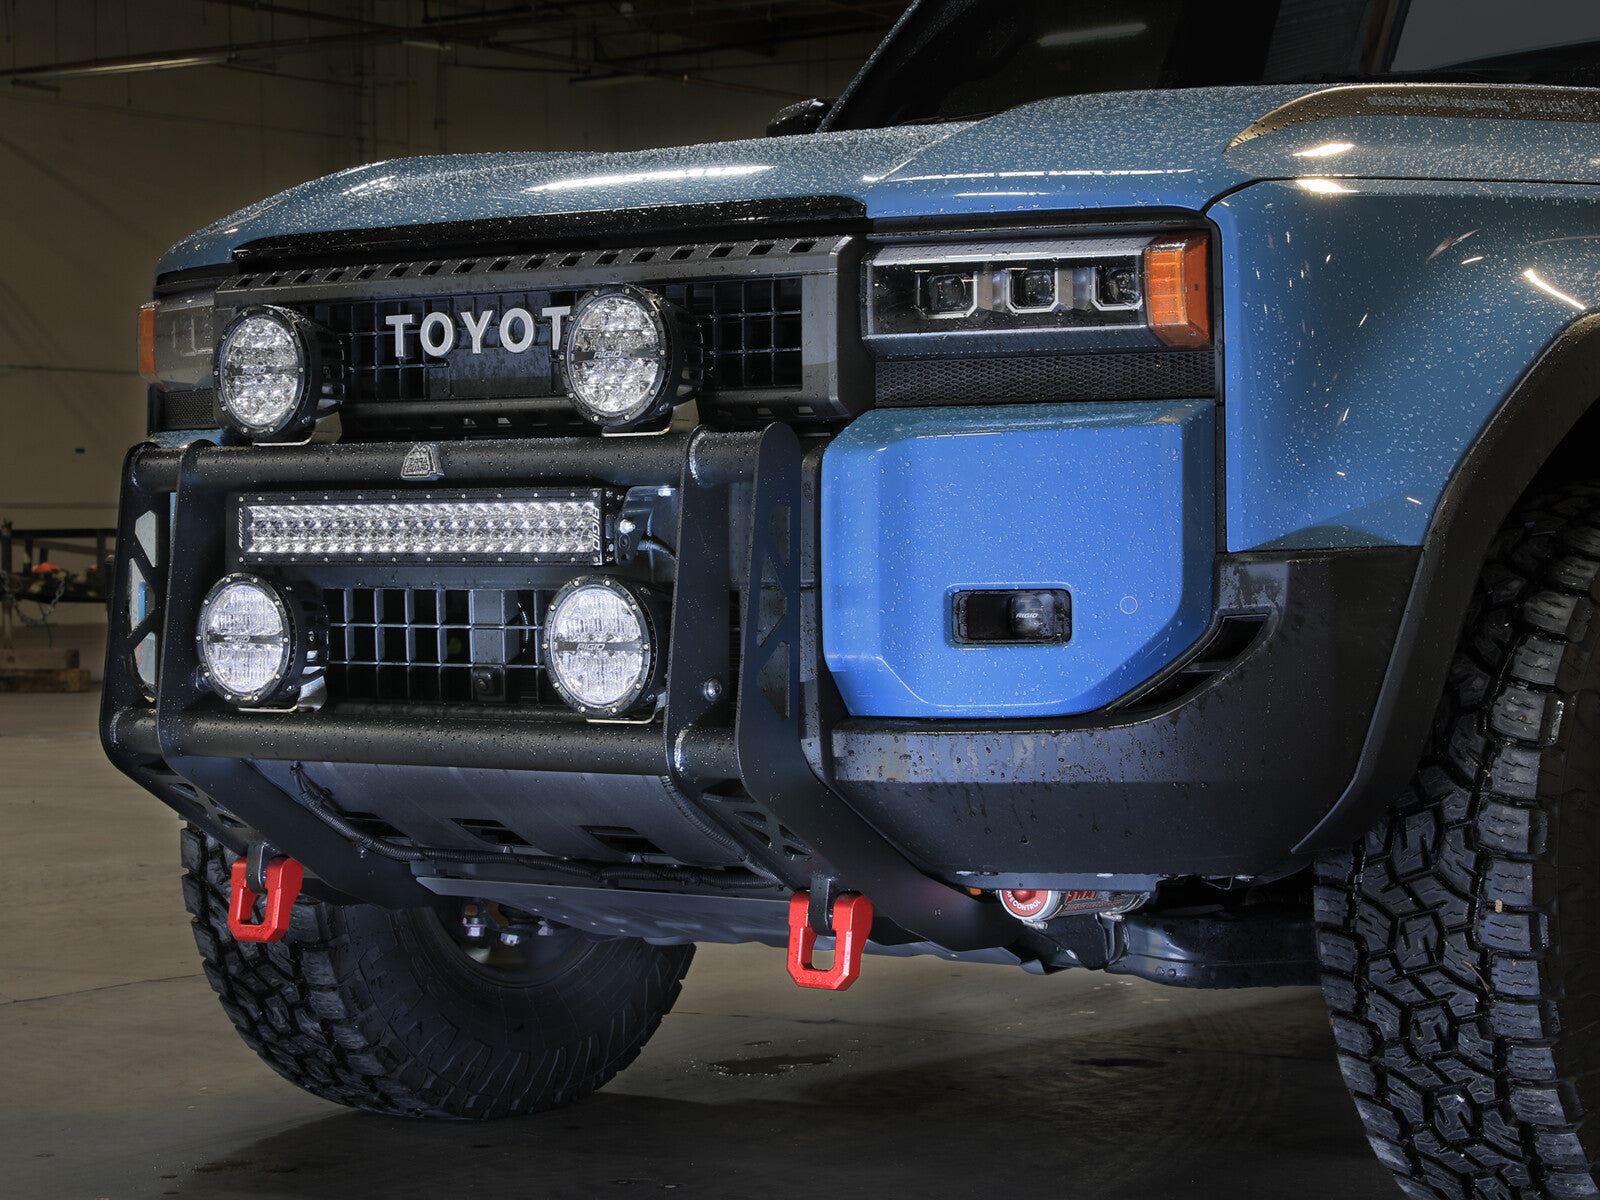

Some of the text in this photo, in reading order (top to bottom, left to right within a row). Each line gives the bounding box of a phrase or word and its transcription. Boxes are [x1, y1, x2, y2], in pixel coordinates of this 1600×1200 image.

[385, 305, 571, 358] TOYOT
[593, 350, 622, 359] RIGID
[591, 504, 600, 551] RIGID
[576, 642, 606, 651] RIGID
[1012, 900, 1041, 911] CONTROL
